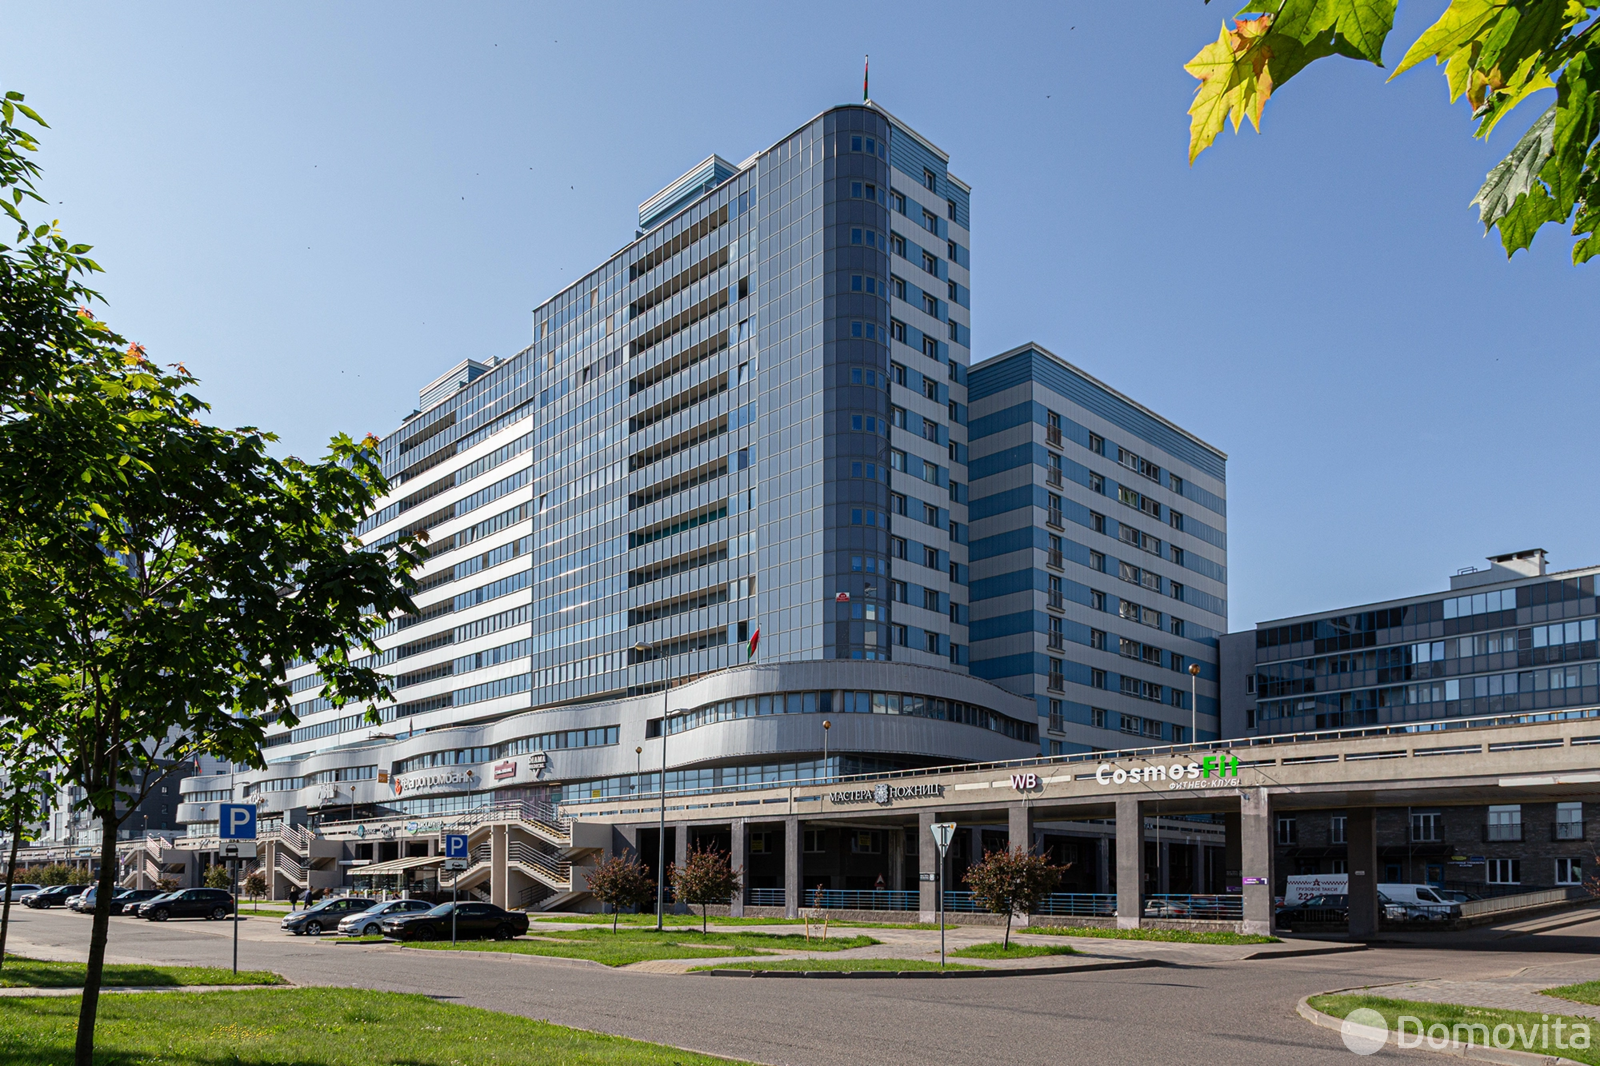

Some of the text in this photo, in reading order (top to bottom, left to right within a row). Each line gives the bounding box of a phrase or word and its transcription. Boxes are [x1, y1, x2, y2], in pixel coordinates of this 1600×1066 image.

[1095, 754, 1239, 786] CosmosFit
[1010, 773, 1037, 790] WB
[829, 783, 940, 802] МАСТЕРА НОЖНИЦ
